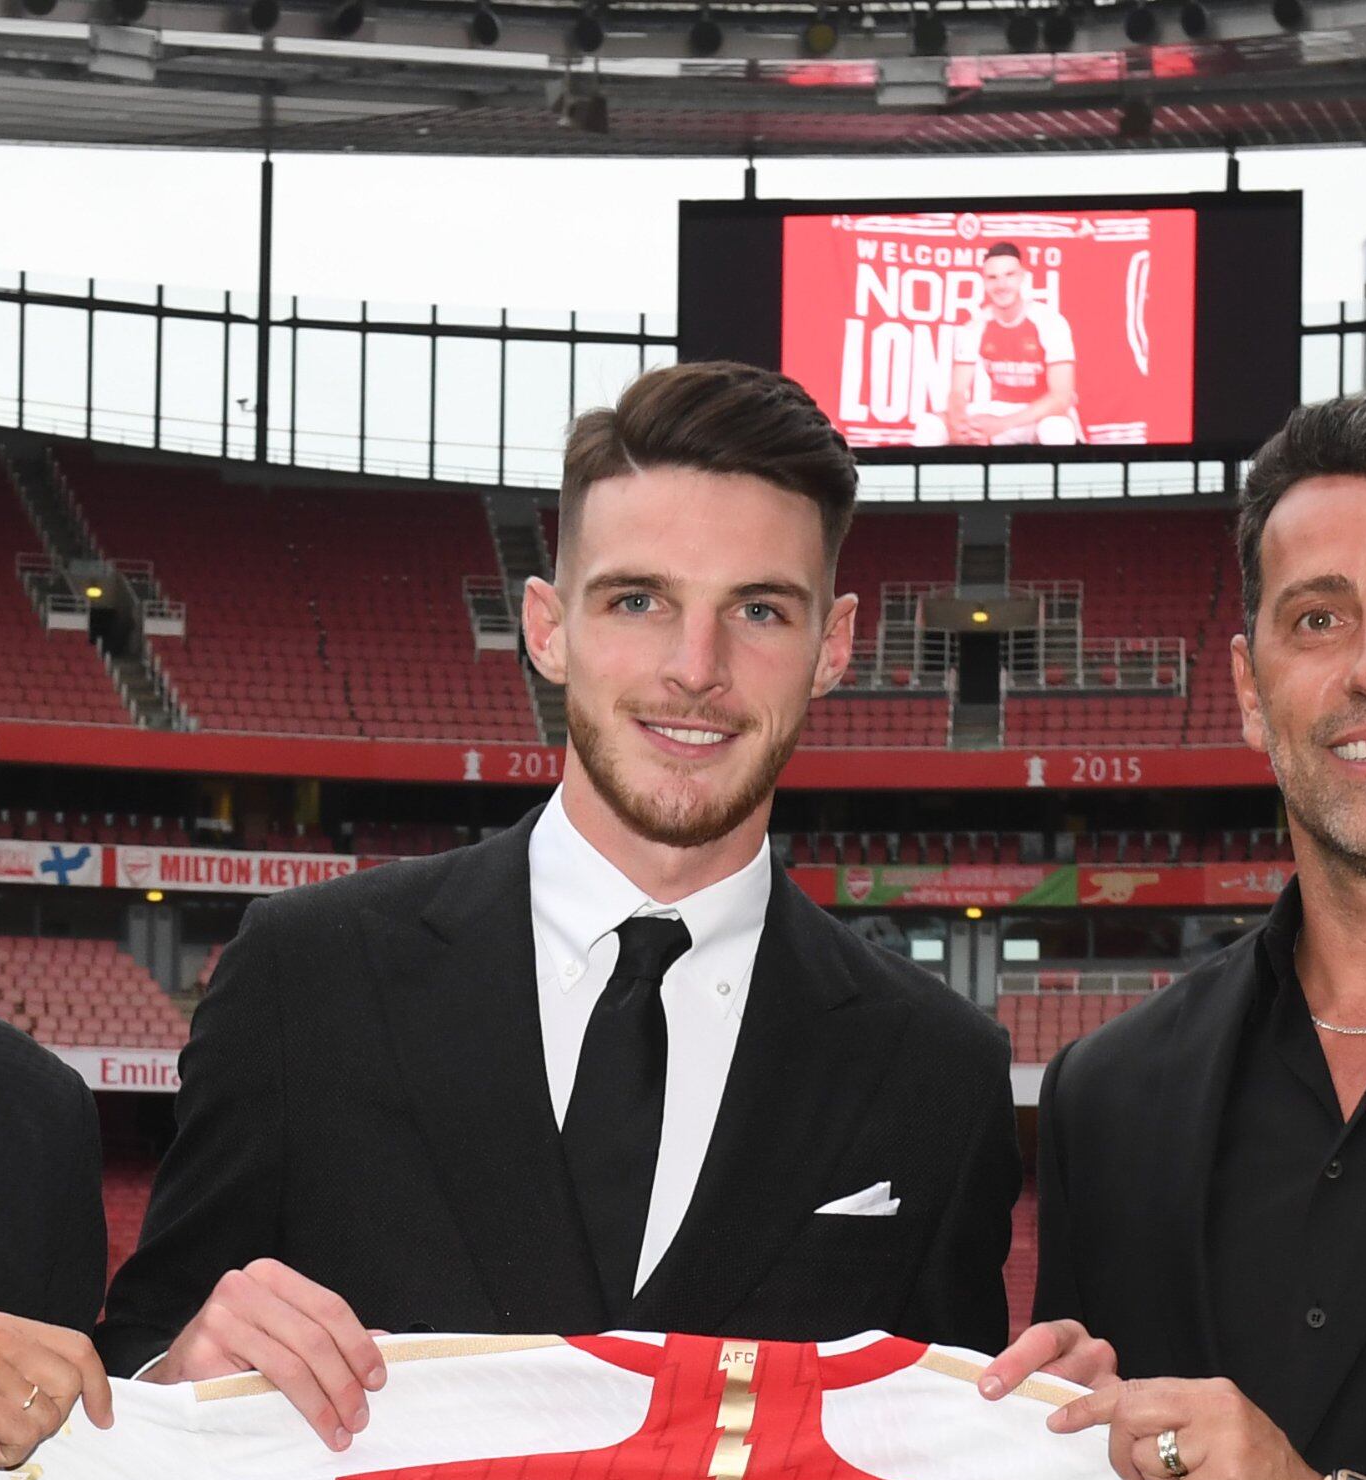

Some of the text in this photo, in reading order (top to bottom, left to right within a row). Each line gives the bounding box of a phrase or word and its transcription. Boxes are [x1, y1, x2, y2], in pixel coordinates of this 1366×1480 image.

[1027, 246, 1063, 268] TO
[855, 262, 1060, 323] NORH
[508, 751, 558, 779] 201
[1071, 755, 1143, 785] 2015
[161, 854, 351, 887] MILTON KEYNES
[722, 1351, 754, 1364] AFC
